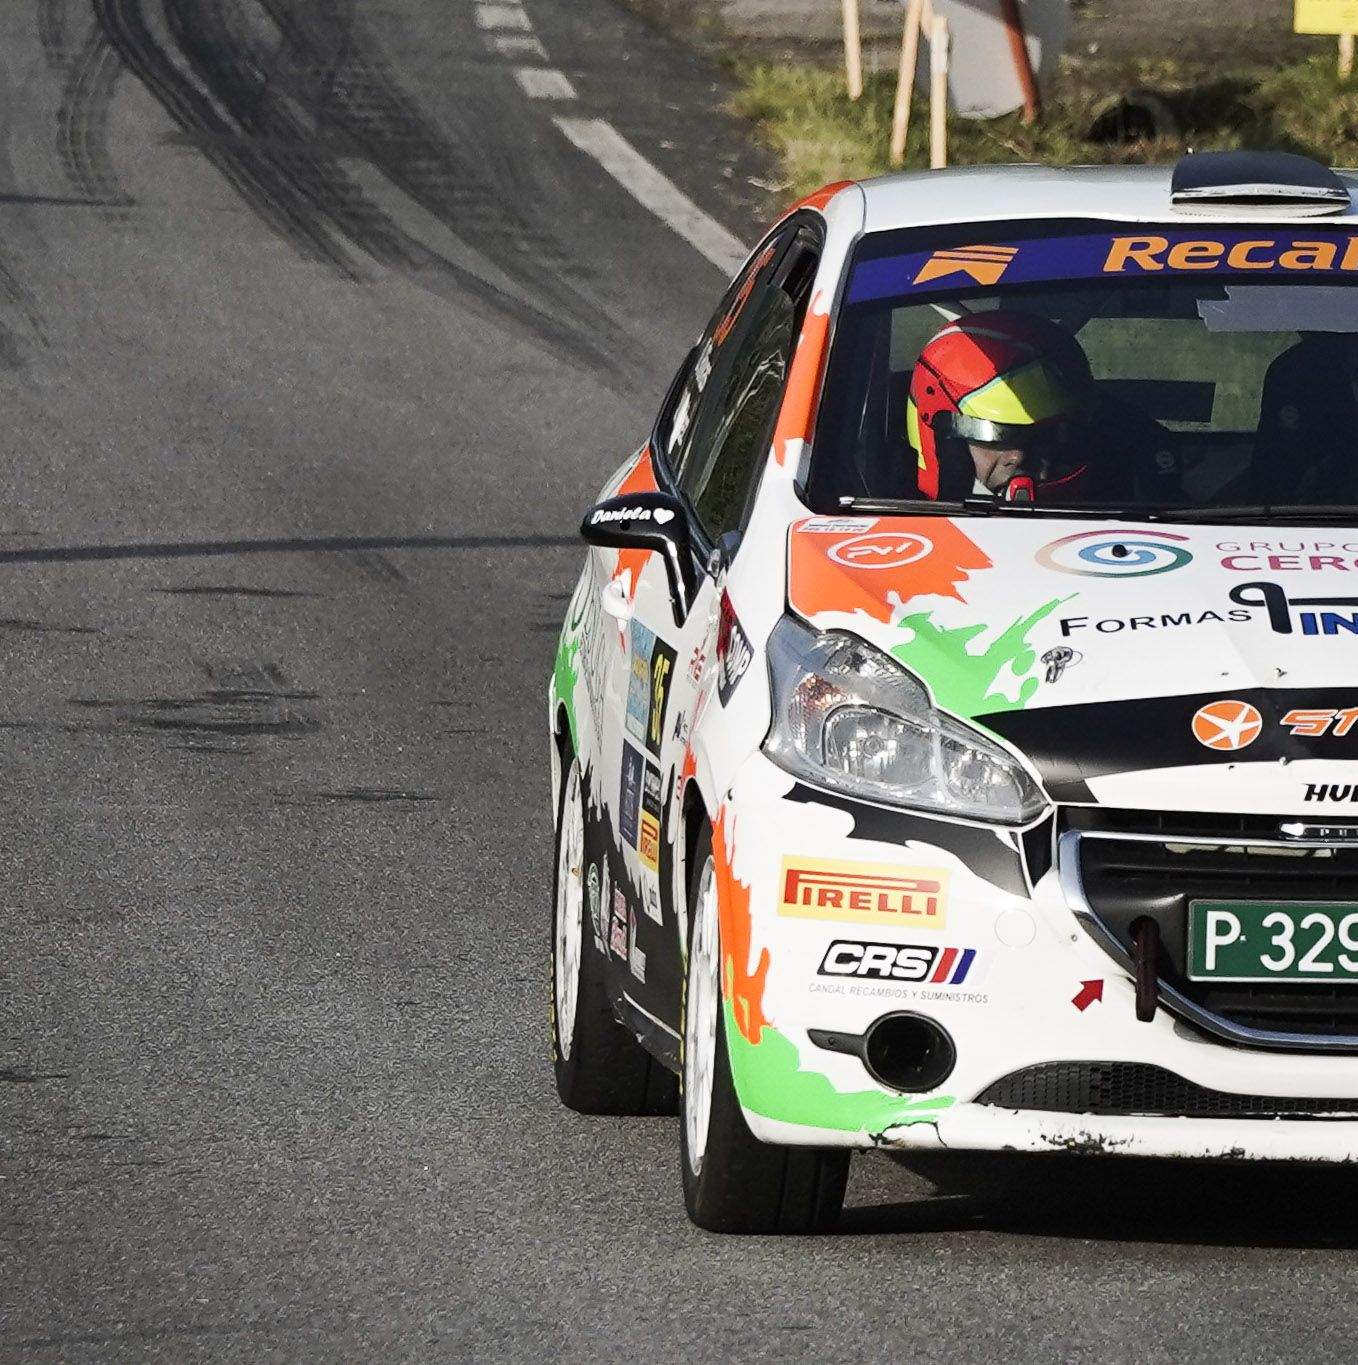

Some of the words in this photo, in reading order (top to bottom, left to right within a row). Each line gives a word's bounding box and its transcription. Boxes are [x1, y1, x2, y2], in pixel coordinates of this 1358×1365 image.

[590, 506, 652, 524] Daniela
[783, 868, 941, 916] PIRELLI
[1204, 910, 1242, 971] P
[823, 943, 934, 978] CRS
[808, 983, 847, 995] CANDAL
[850, 986, 908, 999] RECAMBIOS
[920, 990, 989, 1004] SUMINISTROS
